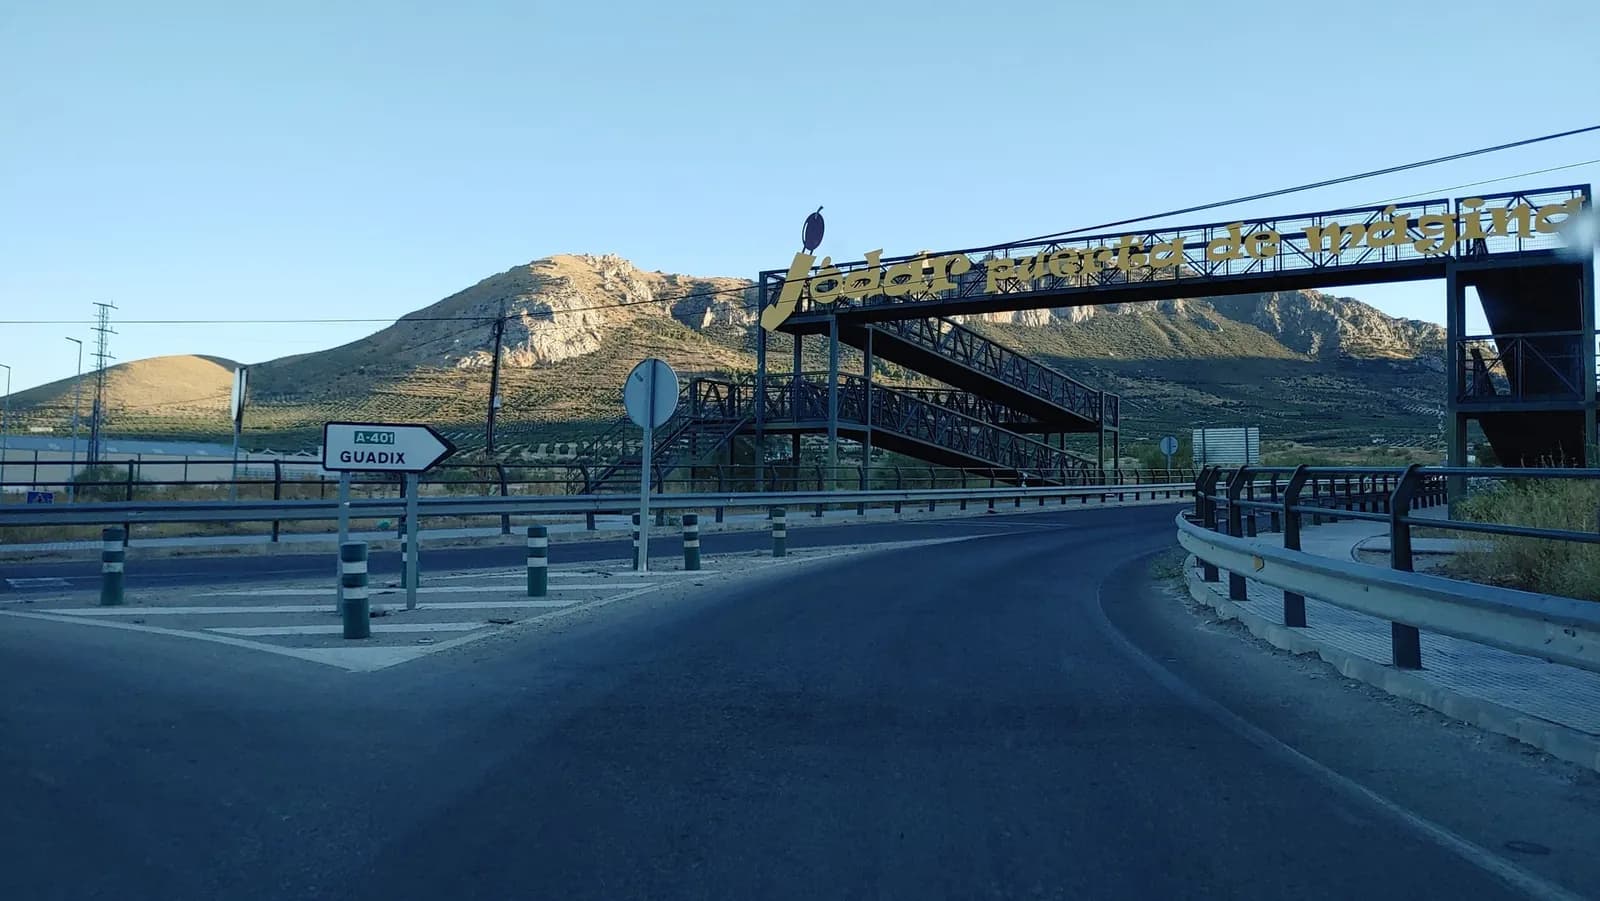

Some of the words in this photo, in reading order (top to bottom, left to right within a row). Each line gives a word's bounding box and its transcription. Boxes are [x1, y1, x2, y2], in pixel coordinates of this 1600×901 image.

[984, 234, 1187, 294] puerta
[1206, 222, 1281, 260] de
[1304, 195, 1585, 255] mágina
[355, 432, 394, 443] A-401
[340, 451, 406, 465] GUADIX
